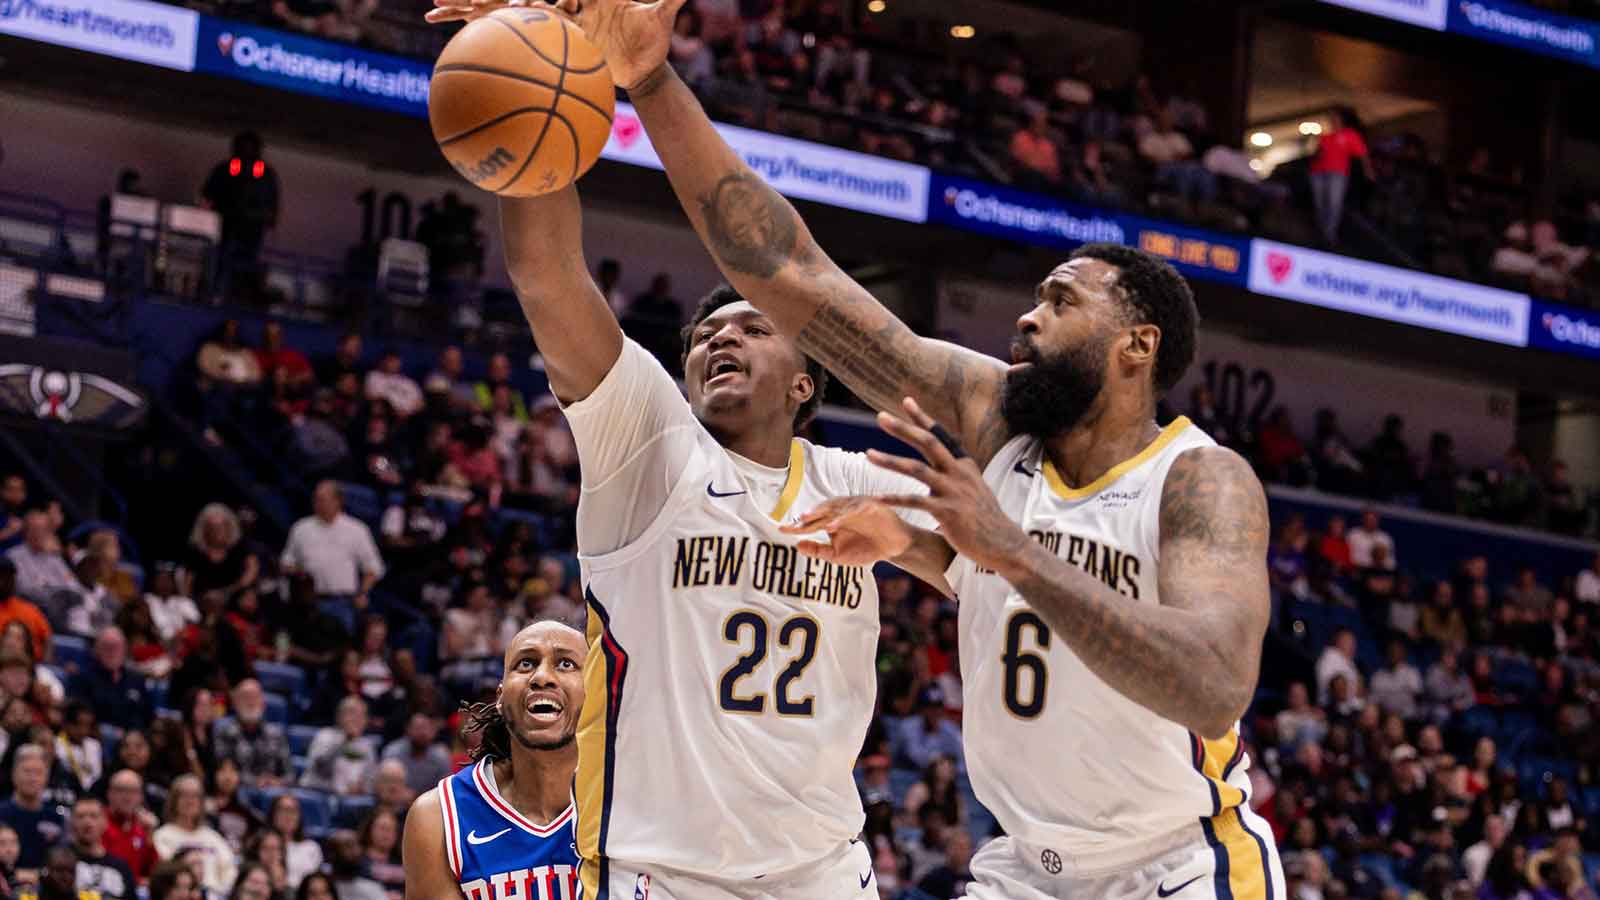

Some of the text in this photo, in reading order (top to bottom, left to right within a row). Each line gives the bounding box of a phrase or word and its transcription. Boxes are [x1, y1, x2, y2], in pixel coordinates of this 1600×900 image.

[1201, 360, 1275, 430] 102
[672, 535, 865, 610] NEW ORLEANS
[716, 608, 822, 718] 22
[1001, 608, 1052, 721] 6
